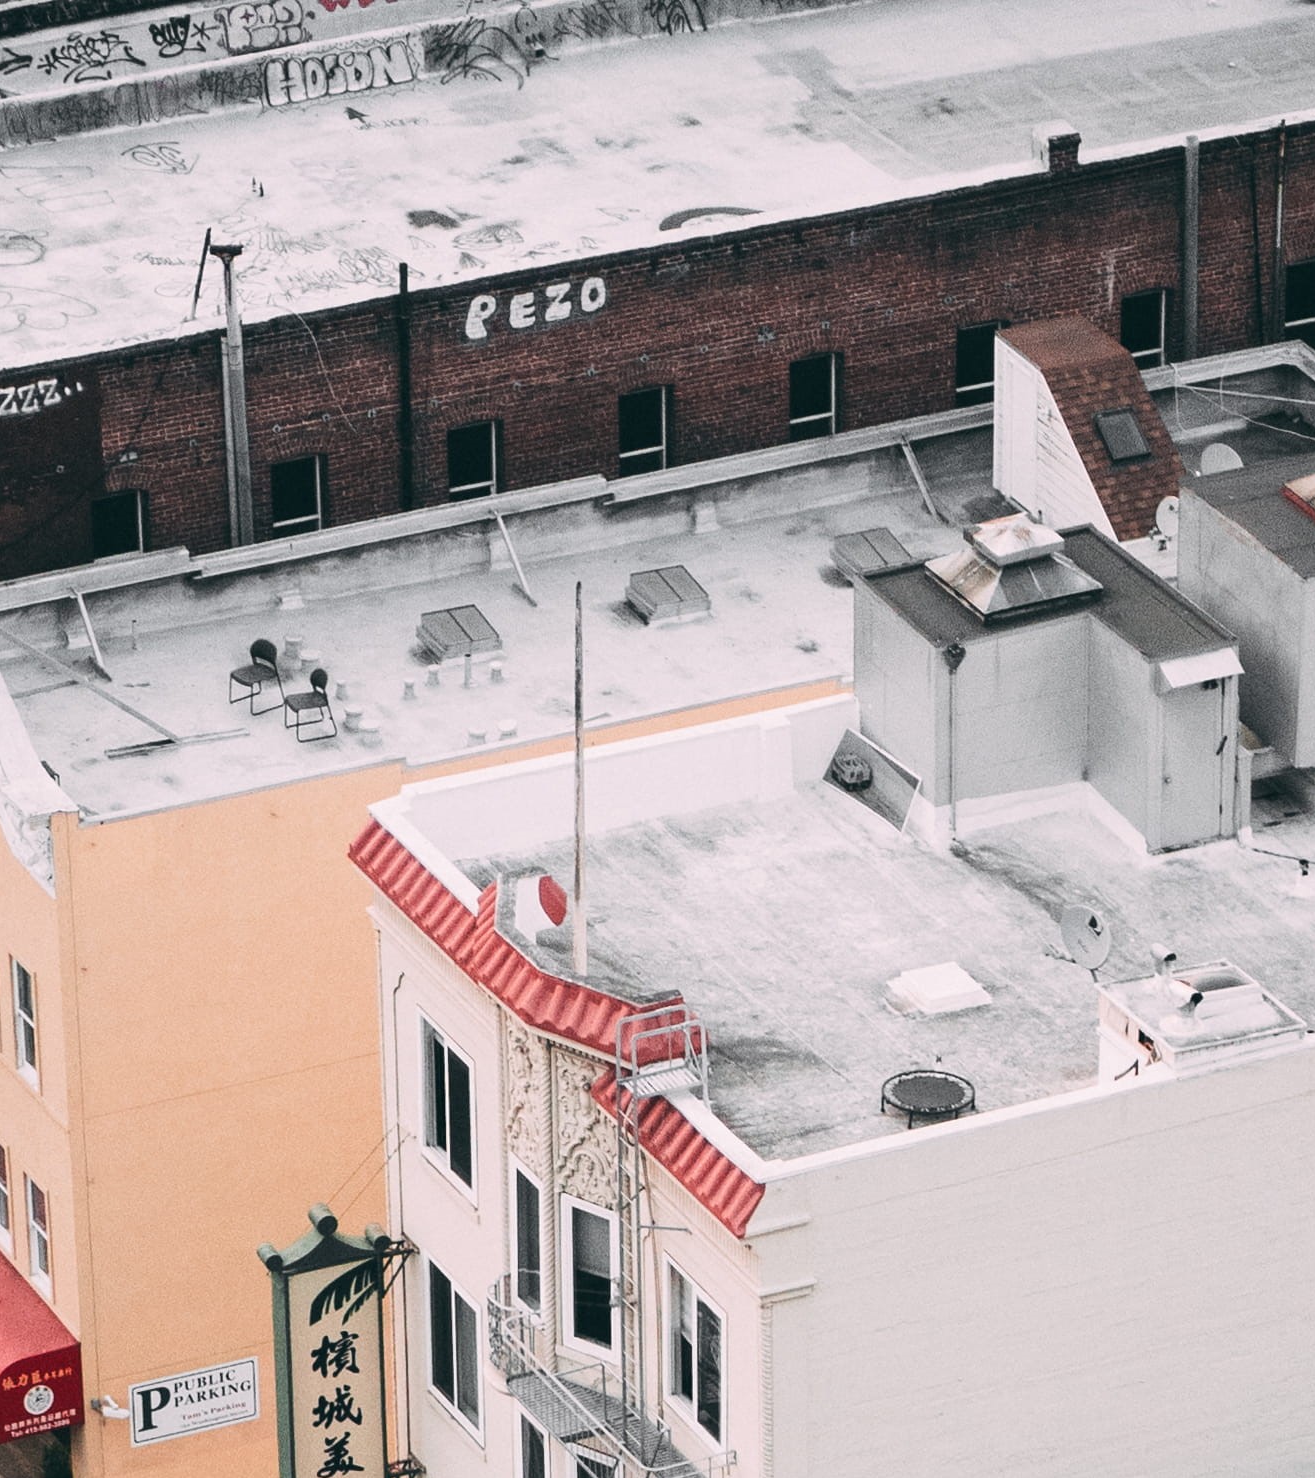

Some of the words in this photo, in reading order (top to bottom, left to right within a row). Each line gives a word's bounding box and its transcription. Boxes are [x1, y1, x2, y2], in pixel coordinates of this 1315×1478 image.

[465, 276, 606, 340] PEZO
[174, 1369, 236, 1394] PUBLIC
[174, 1380, 252, 1407] PARKING
[137, 1386, 171, 1433] P
